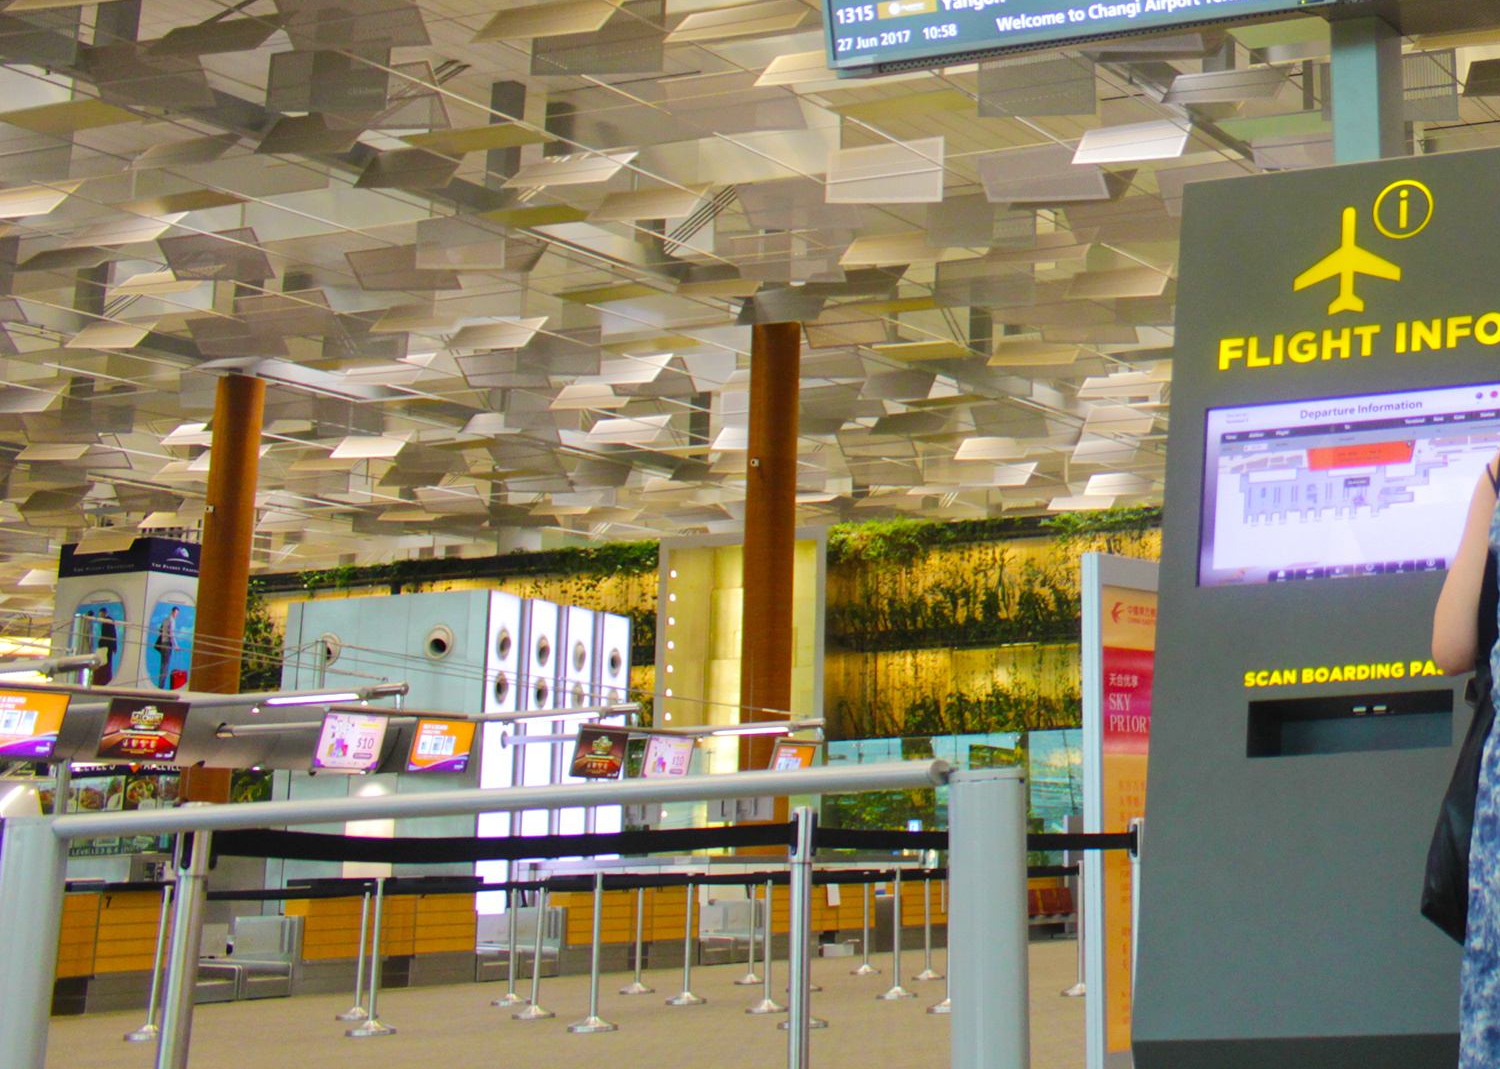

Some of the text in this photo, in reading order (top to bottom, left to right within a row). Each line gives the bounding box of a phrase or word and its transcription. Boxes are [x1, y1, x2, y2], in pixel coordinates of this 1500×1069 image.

[996, 12, 1065, 31] Welcome
[1067, 8, 1085, 22] to
[837, 23, 957, 51] 27 Jun 2017 10:58
[1219, 325, 1380, 370] FLIGHT
[1300, 400, 1423, 420] Departure Information
[1245, 660, 1444, 687] SCAN BOARDING PA
[1109, 693, 1131, 711] SKY
[1110, 716, 1152, 733] PRIOR
